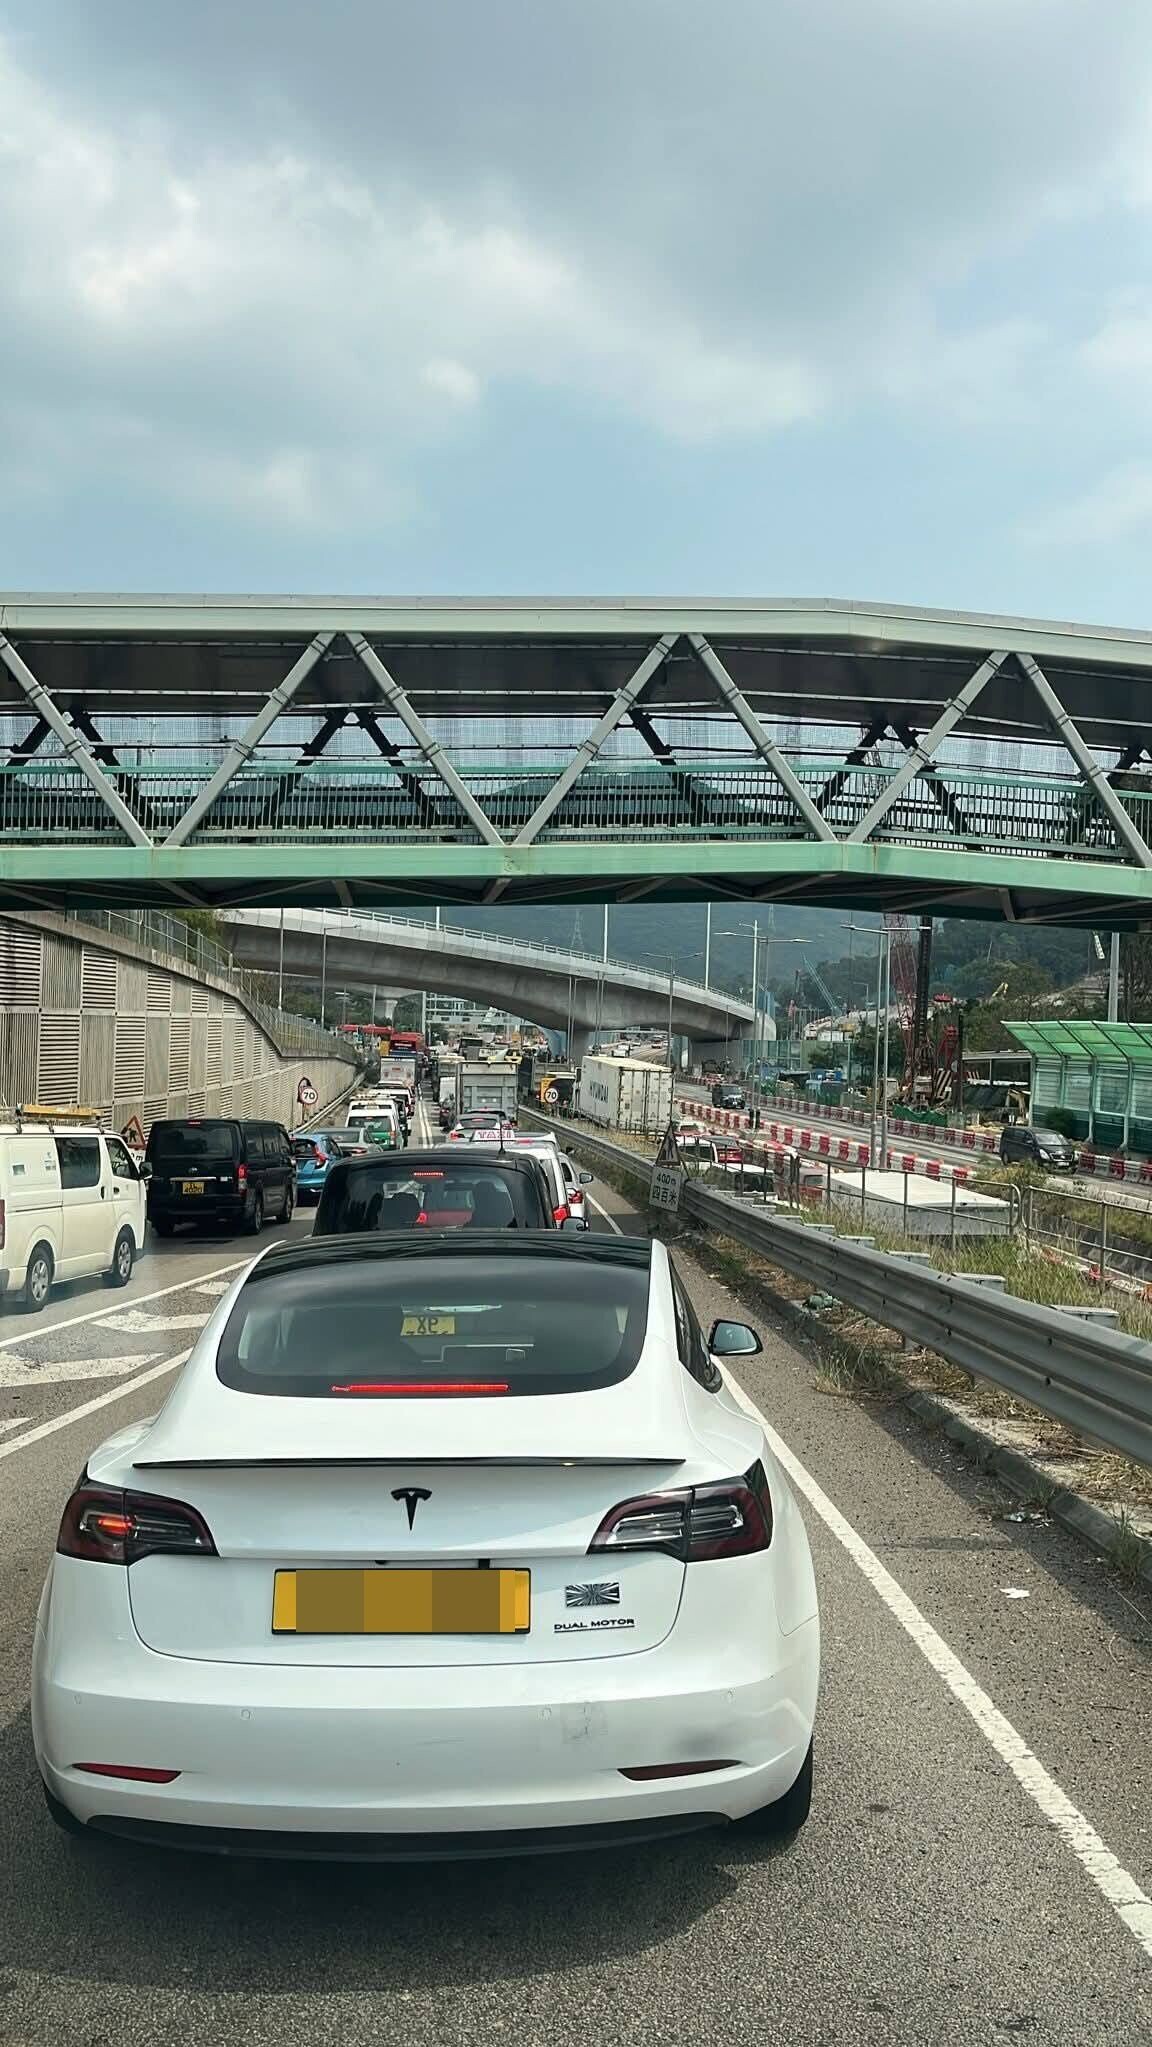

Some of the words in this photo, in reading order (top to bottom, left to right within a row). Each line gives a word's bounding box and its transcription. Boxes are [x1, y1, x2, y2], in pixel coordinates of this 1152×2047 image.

[304, 1092, 315, 1100] 70
[546, 1091, 557, 1100] 70
[477, 1130, 512, 1139] TAXI
[652, 1184, 678, 1206] 四百米
[554, 1622, 588, 1630] DUAL
[590, 1619, 634, 1627] MOTOR
